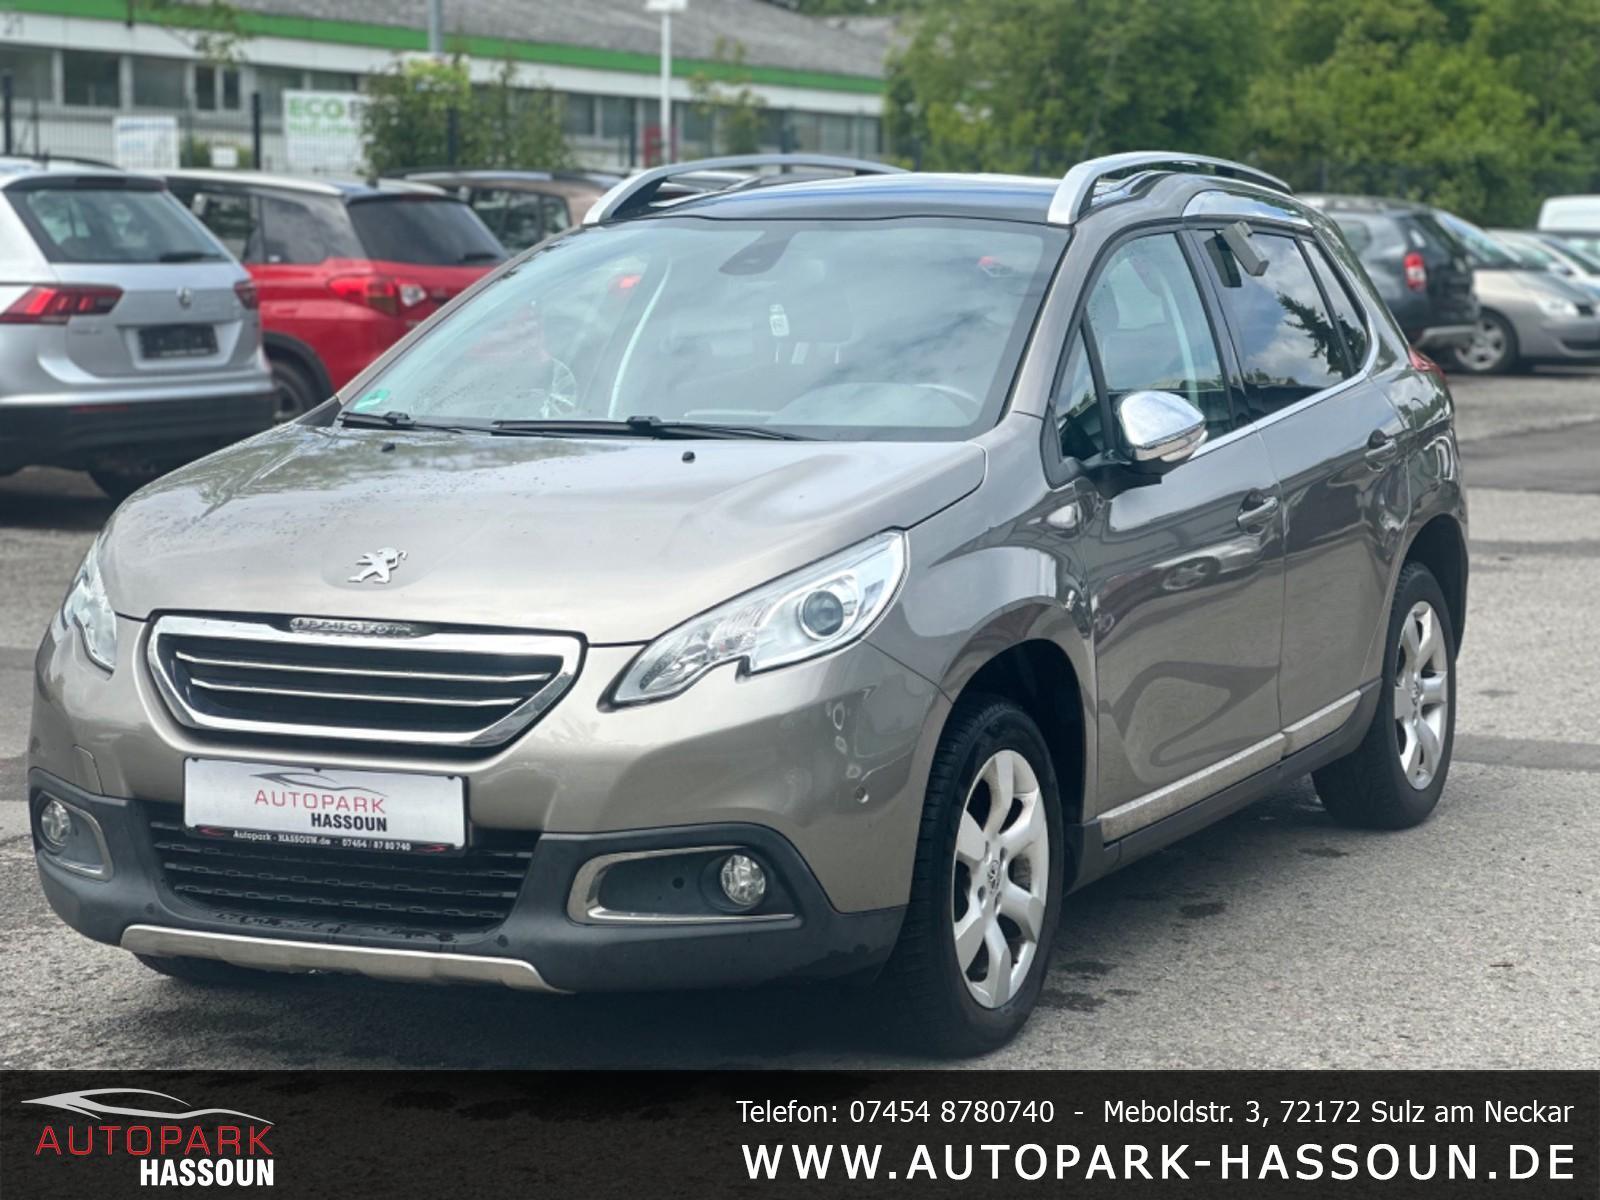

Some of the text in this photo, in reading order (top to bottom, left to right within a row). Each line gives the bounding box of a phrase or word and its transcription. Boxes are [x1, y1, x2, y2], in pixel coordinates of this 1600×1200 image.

[287, 98, 345, 120] ECO
[254, 789, 387, 815] AUTOPARK
[311, 812, 388, 832] HASSOUN
[233, 829, 272, 843] Autopark
